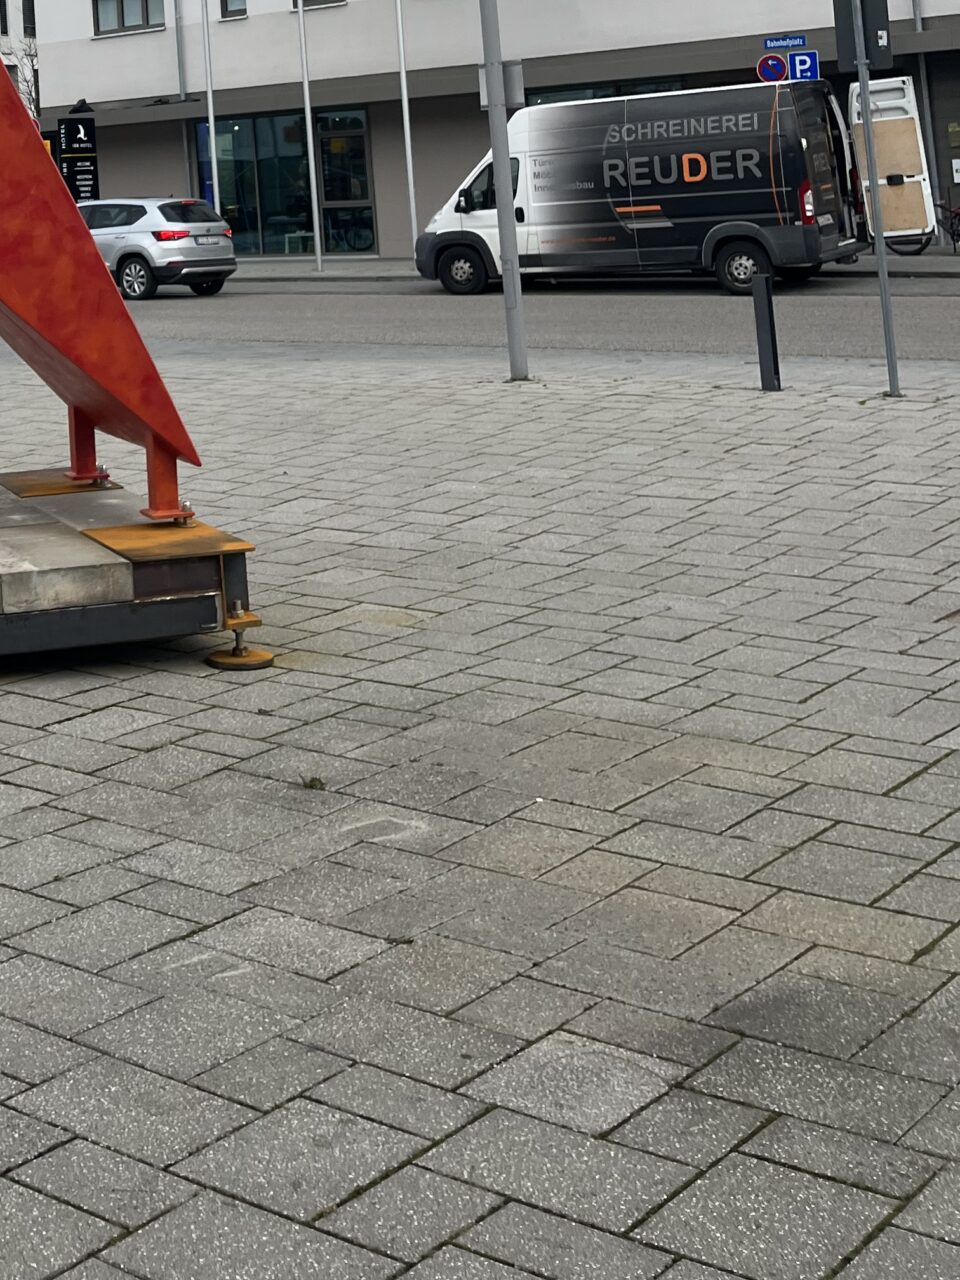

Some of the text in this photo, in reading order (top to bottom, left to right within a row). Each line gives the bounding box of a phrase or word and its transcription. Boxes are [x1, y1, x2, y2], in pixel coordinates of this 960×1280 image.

[795, 55, 811, 78] P
[608, 113, 759, 143] SCHREINEREI
[602, 148, 762, 188] REUDER
